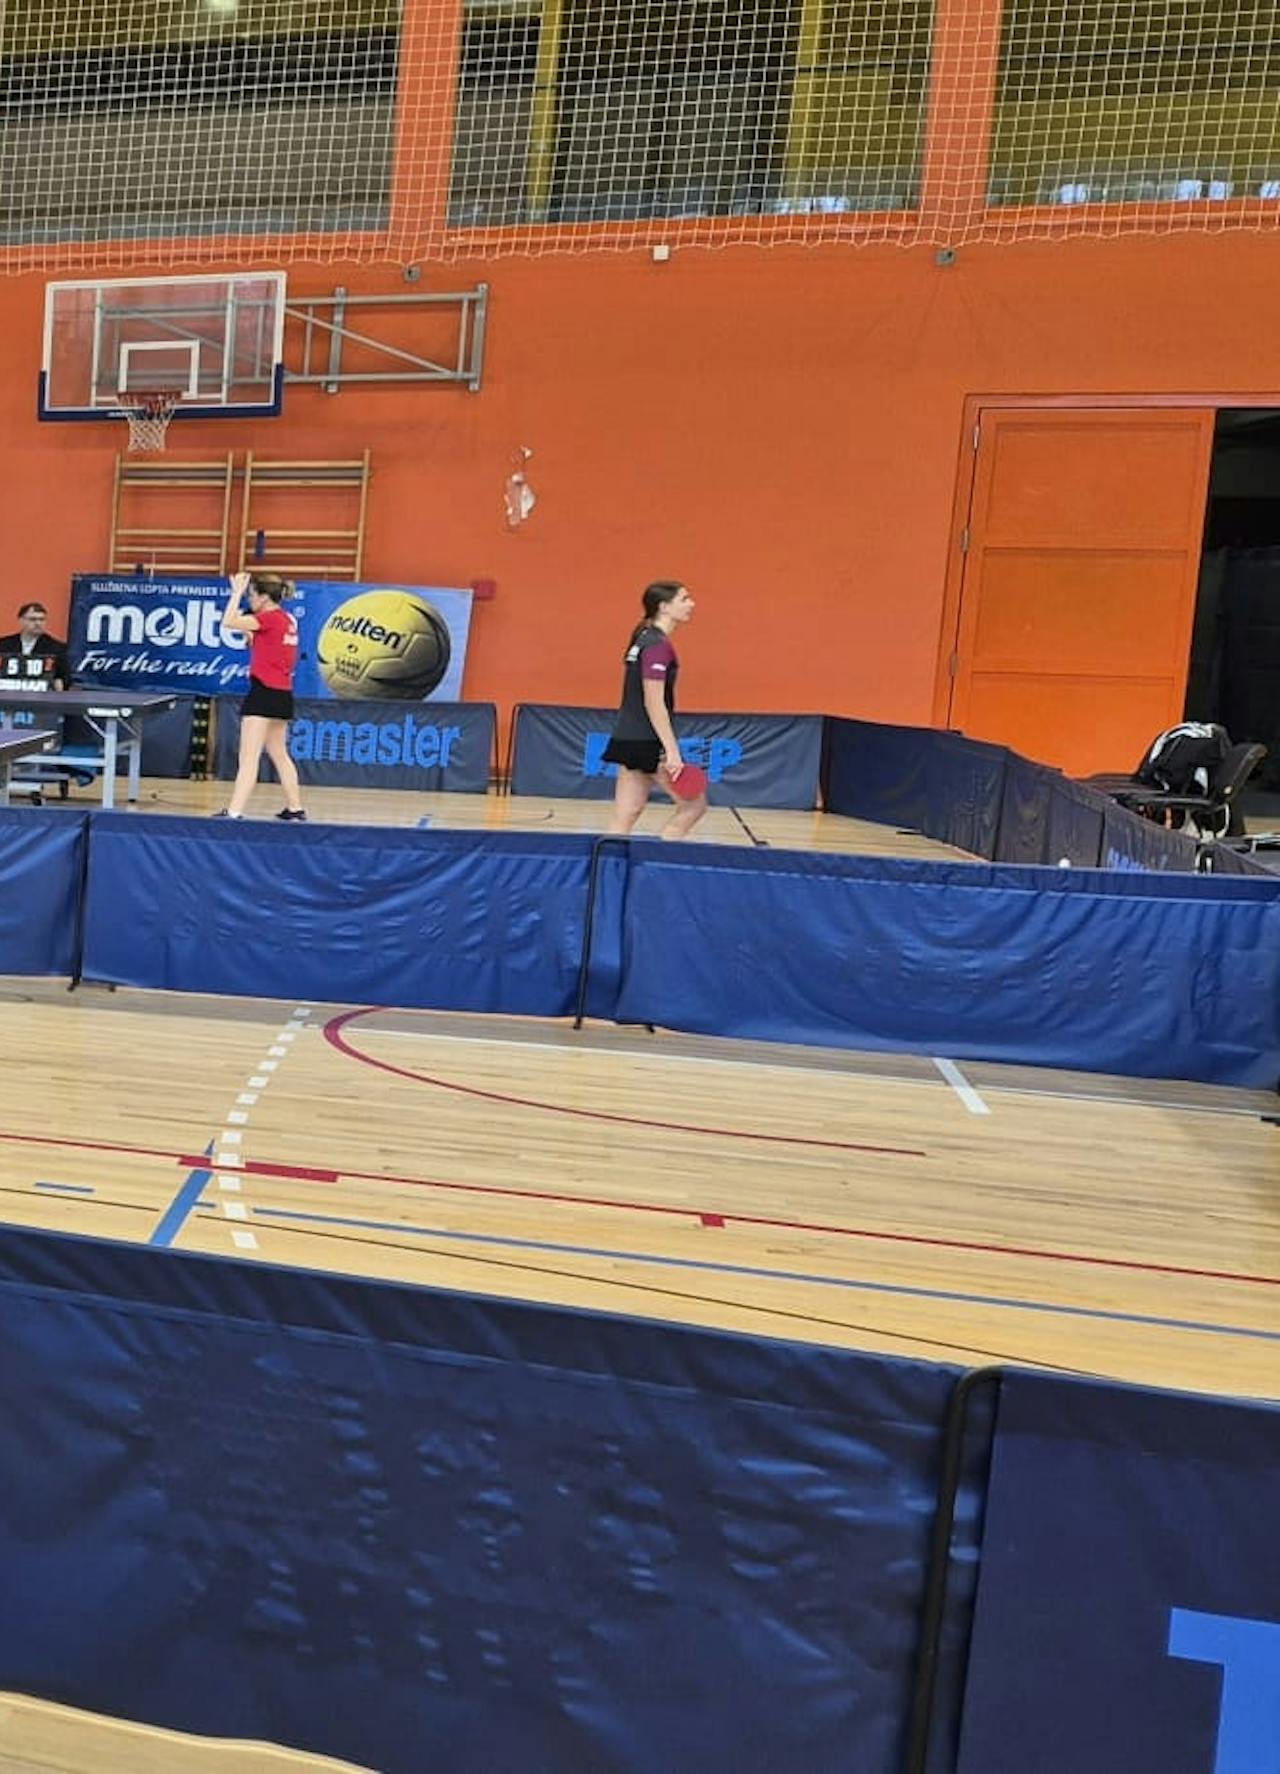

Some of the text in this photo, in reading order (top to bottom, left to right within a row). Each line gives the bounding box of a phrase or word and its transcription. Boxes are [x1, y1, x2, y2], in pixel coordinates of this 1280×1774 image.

[77, 650, 121, 672] For
[121, 651, 162, 674] the
[165, 654, 219, 677] real
